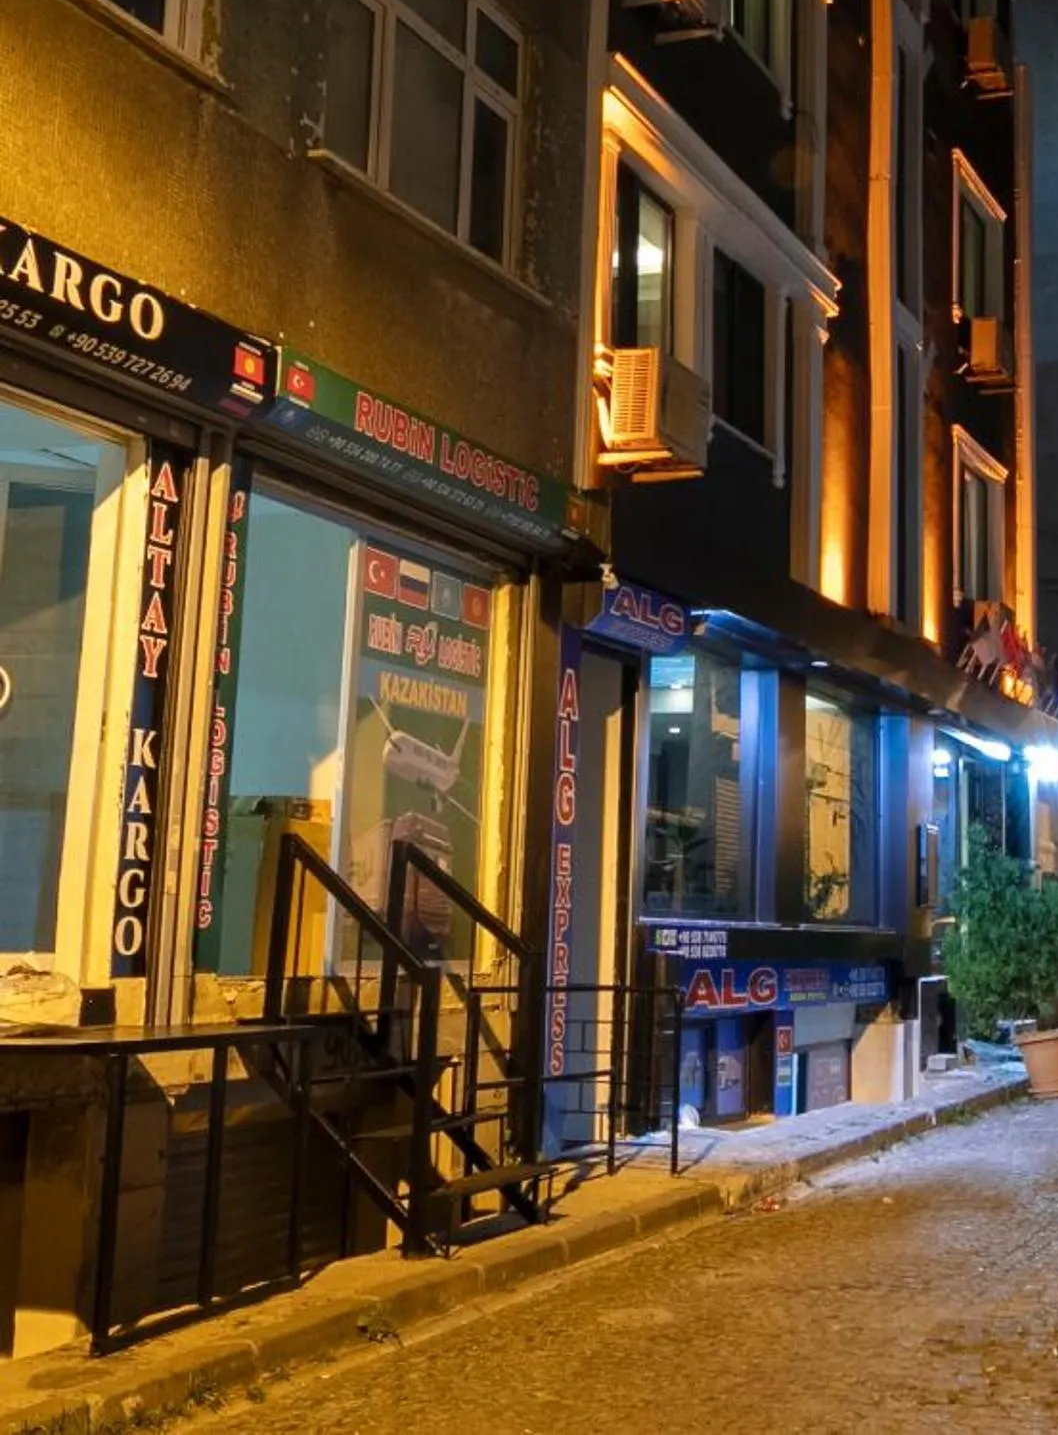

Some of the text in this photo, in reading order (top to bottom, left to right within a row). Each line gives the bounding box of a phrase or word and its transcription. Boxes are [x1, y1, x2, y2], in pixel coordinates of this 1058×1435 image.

[115, 461, 178, 957] ALTAY KARGO
[610, 586, 685, 637] ALG
[551, 667, 579, 1077] ALG EXPRESS
[684, 967, 779, 1011] ALG
